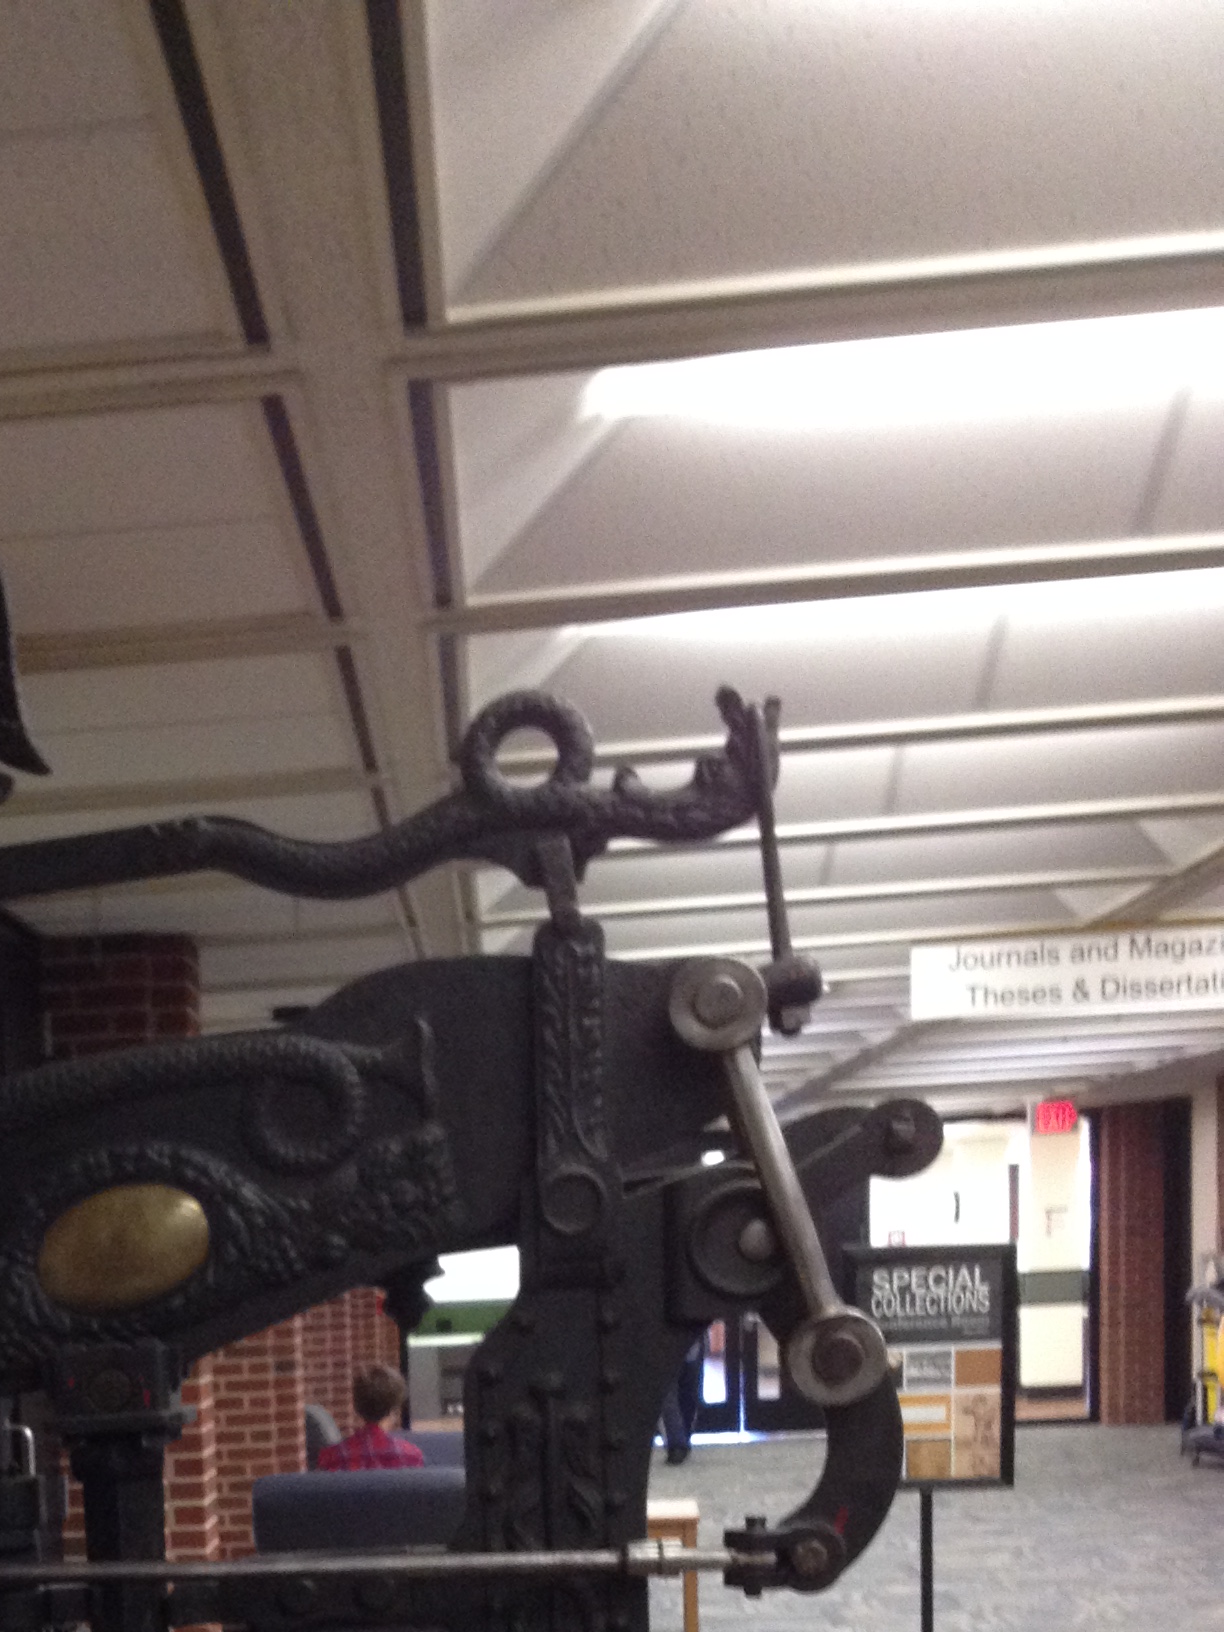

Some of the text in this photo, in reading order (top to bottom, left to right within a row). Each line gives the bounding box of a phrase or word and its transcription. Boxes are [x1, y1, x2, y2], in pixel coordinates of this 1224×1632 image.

[948, 941, 1061, 972] Journals
[1071, 936, 1119, 963] and
[966, 981, 1063, 1009] Theses
[1072, 977, 1091, 1002] &
[1038, 1103, 1072, 1132] EXIT
[872, 1263, 989, 1296] SPECIAL
[871, 1284, 991, 1319] COLLECTIONS
